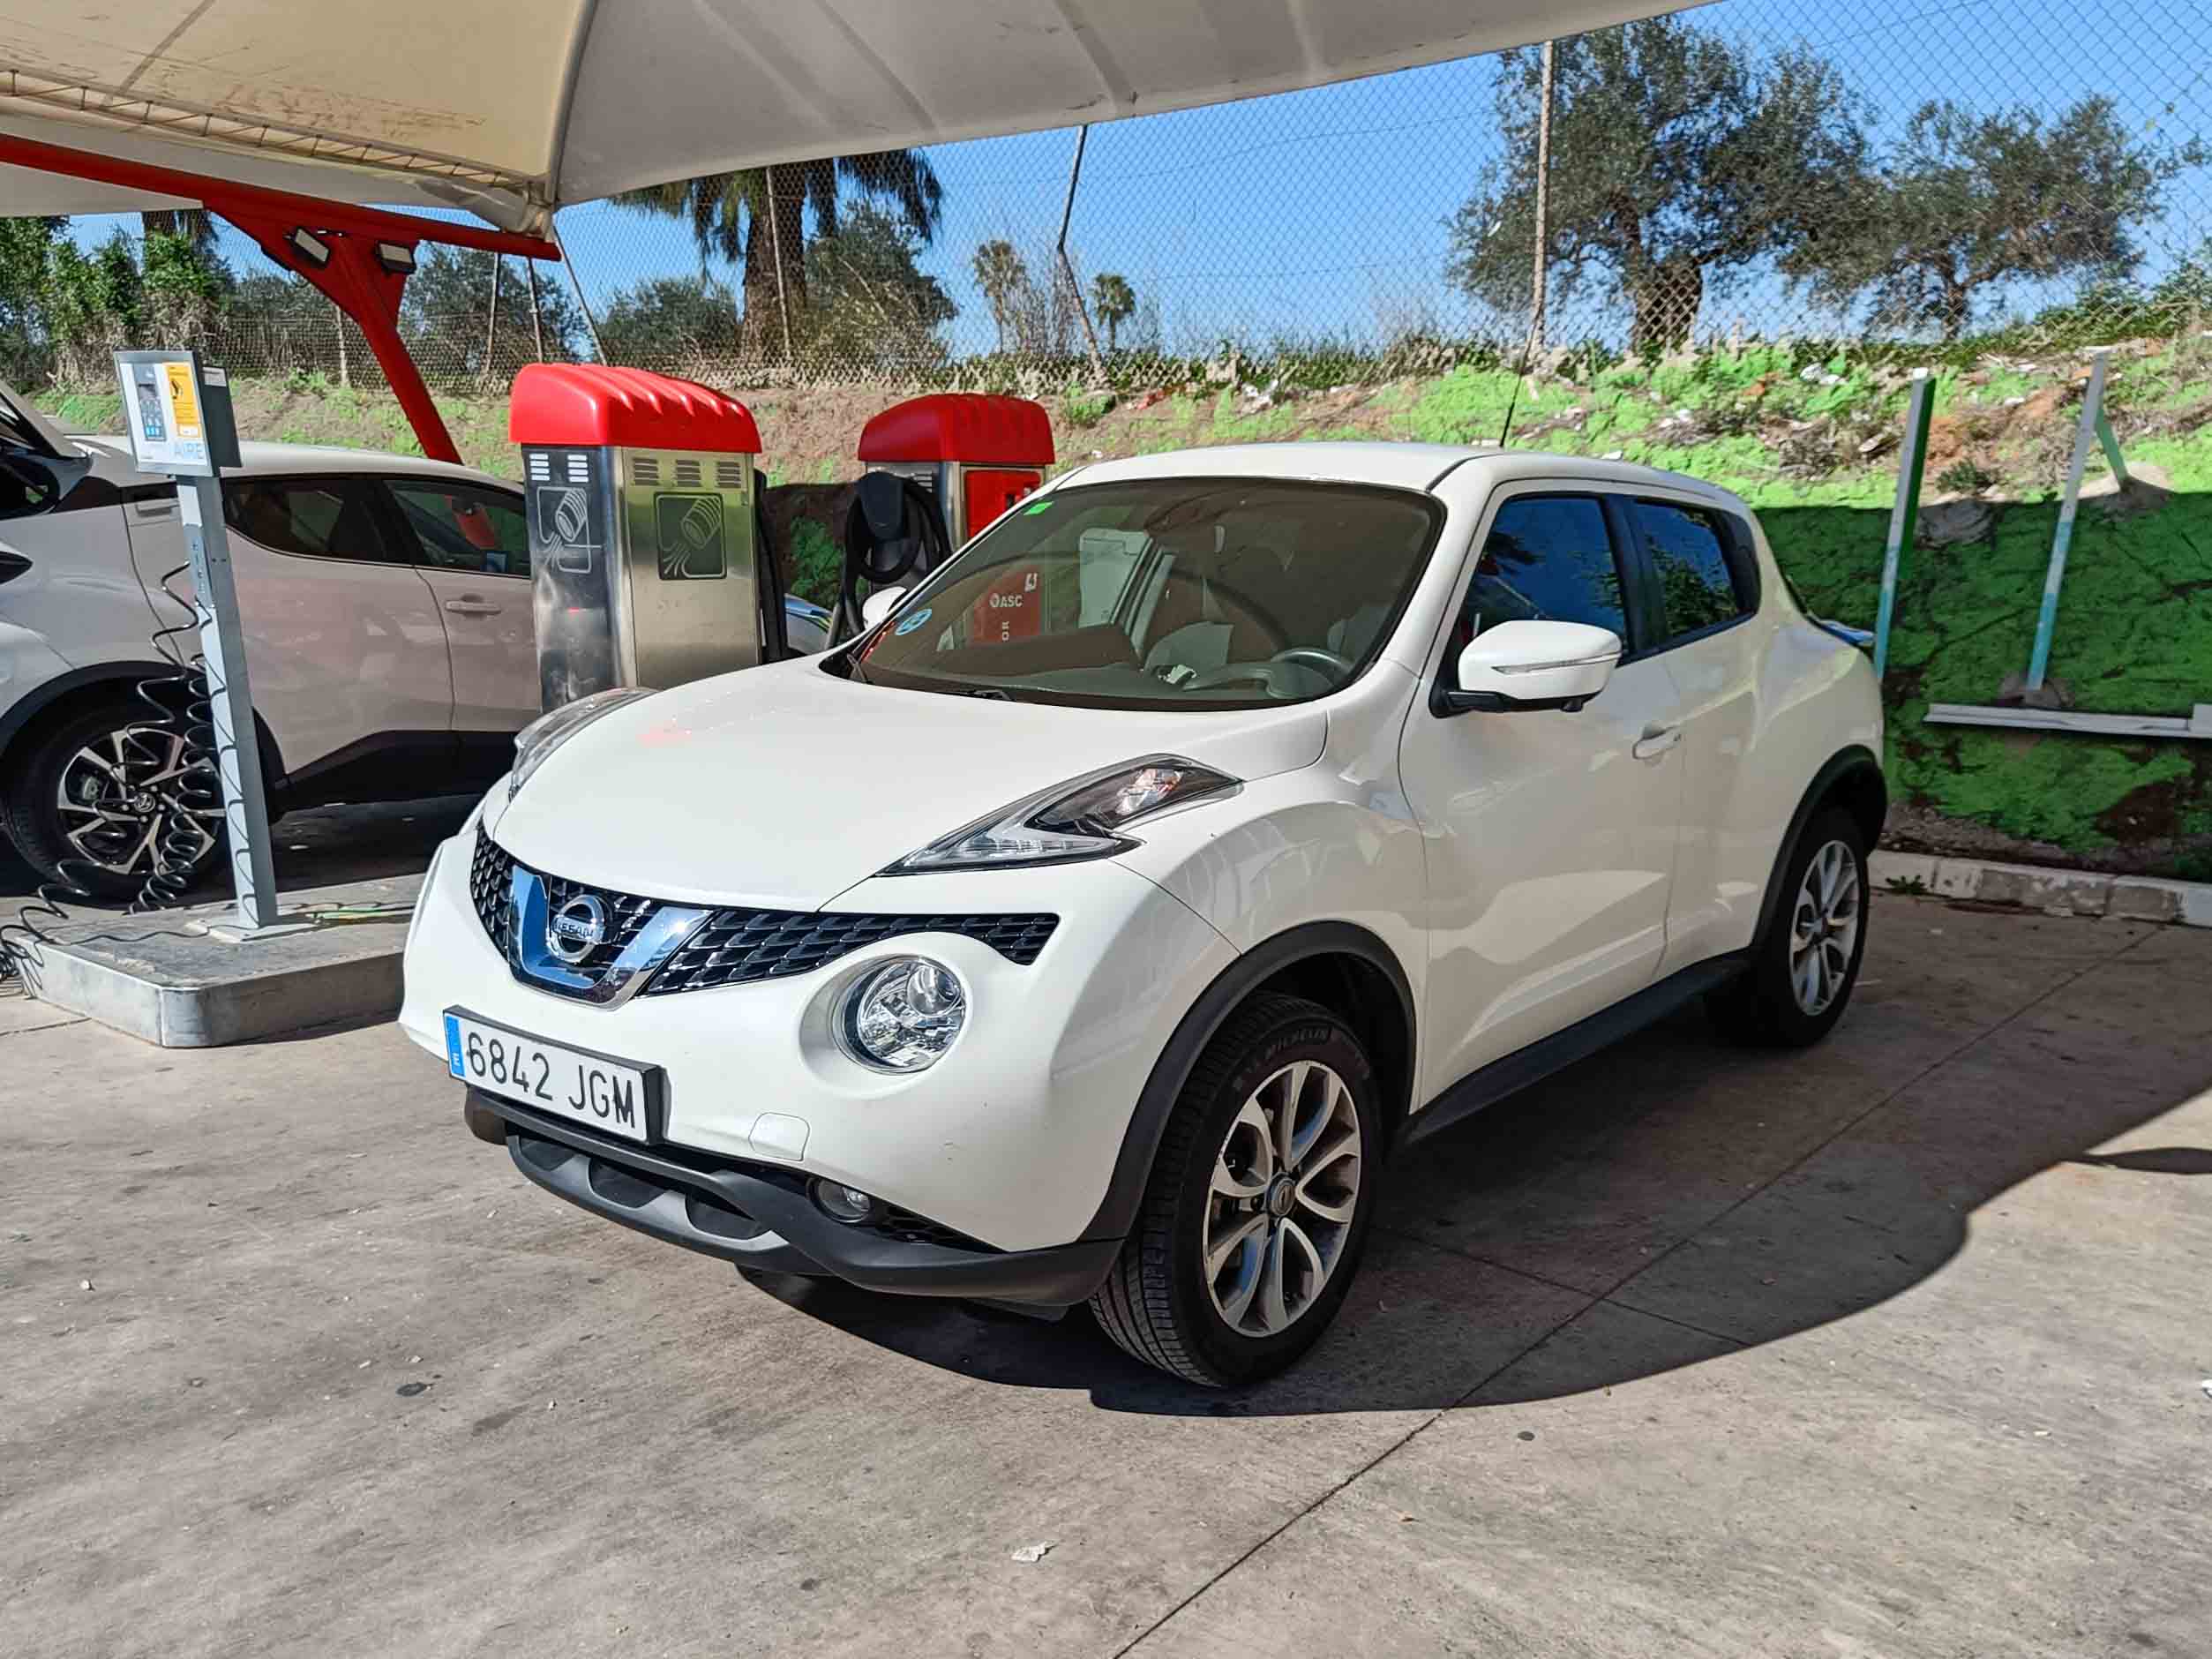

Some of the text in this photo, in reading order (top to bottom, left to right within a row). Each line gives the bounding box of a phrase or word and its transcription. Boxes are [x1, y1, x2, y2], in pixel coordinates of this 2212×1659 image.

[453, 1053, 460, 1066] E
[468, 1032, 635, 1129] 6842 JGM
